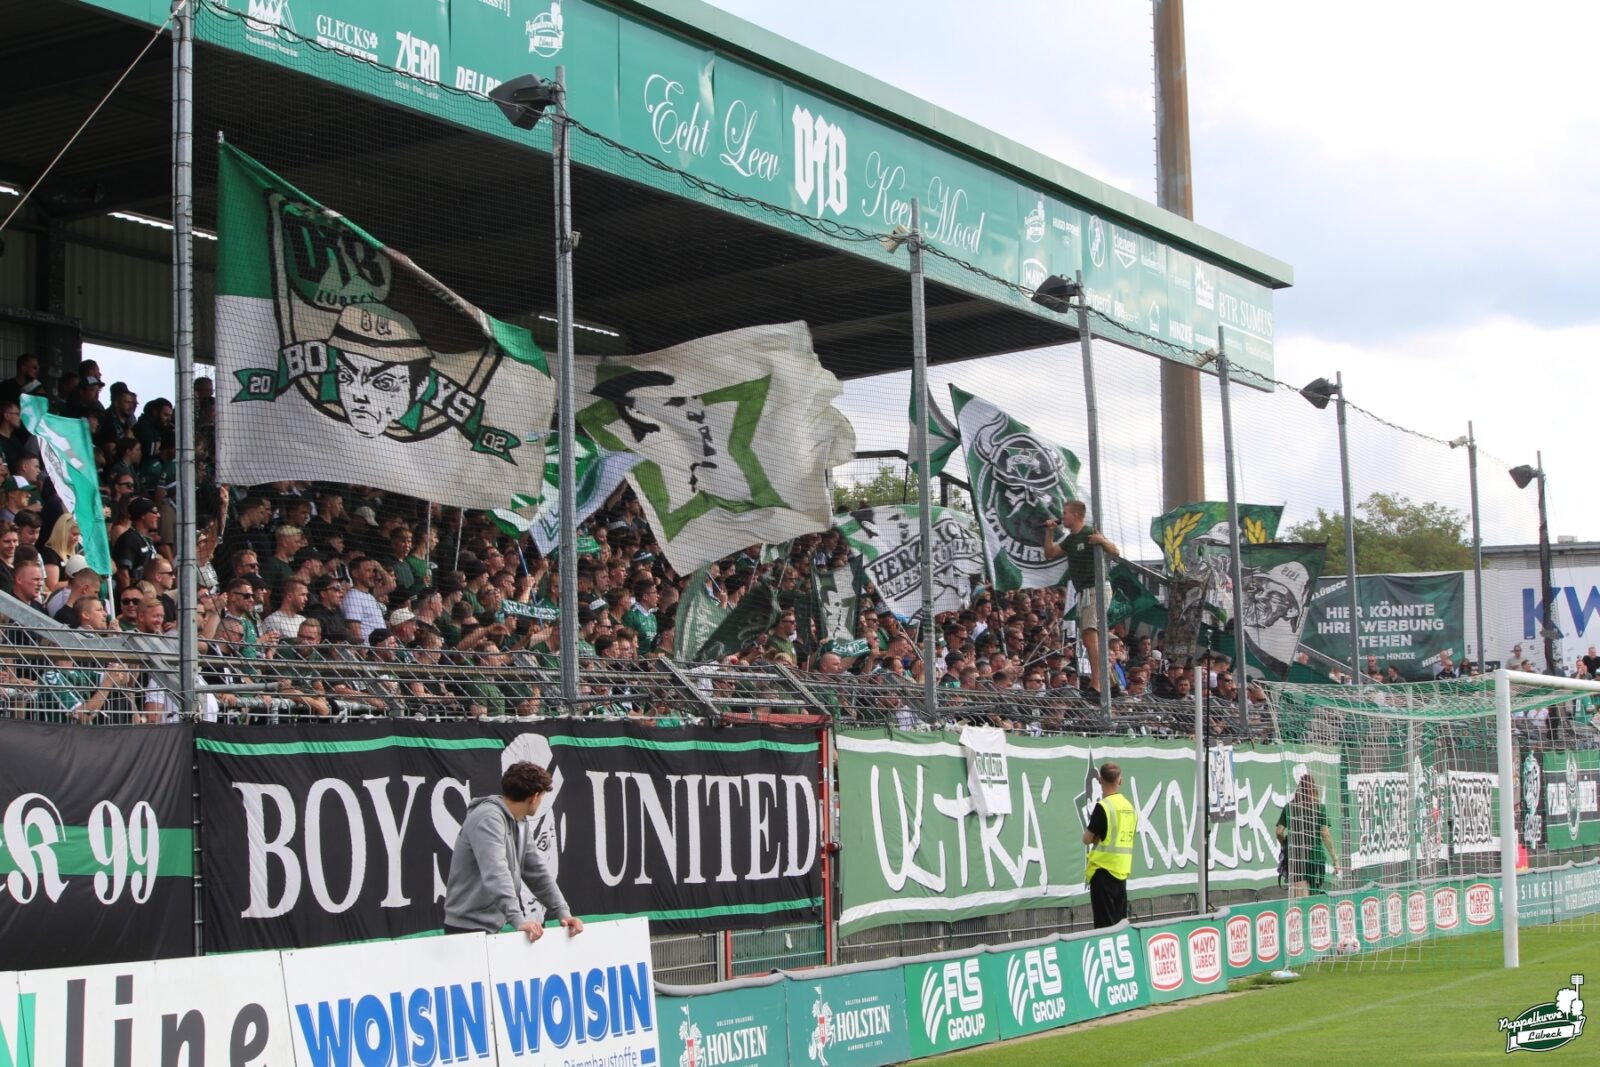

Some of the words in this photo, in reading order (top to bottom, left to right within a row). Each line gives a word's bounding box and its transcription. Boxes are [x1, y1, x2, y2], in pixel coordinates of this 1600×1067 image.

[644, 74, 710, 155] Echt
[720, 100, 781, 180] Leev
[1219, 291, 1240, 323] BTR
[250, 375, 271, 394] 20
[1326, 604, 1363, 620] HIER
[1369, 600, 1435, 618] KÖNNTE
[1360, 618, 1444, 633] WERBUNG
[1358, 634, 1412, 648] TEHEN
[1421, 647, 1454, 668] HINZE
[87, 799, 160, 905] 99
[231, 774, 479, 918] BOYS
[586, 770, 819, 887] UNITED
[1469, 889, 1490, 905] MAYO
[1470, 903, 1490, 916] LÜBECK
[1230, 923, 1248, 939] MAYO
[1259, 919, 1275, 935] MAYO
[1152, 941, 1176, 961] MAYO
[1192, 935, 1216, 955] MAYO
[1154, 960, 1178, 977] LÜBECK
[1194, 953, 1217, 970] LÜBECK
[1106, 980, 1139, 1006] GROUP
[496, 961, 653, 1057] WOISIN
[1031, 997, 1066, 1024] GROUP
[295, 981, 490, 1067] WOISIN
[836, 1004, 890, 1042] HOLSTEN
[947, 1012, 986, 1042] GROUP
[706, 1025, 768, 1066] HOLSTEN
